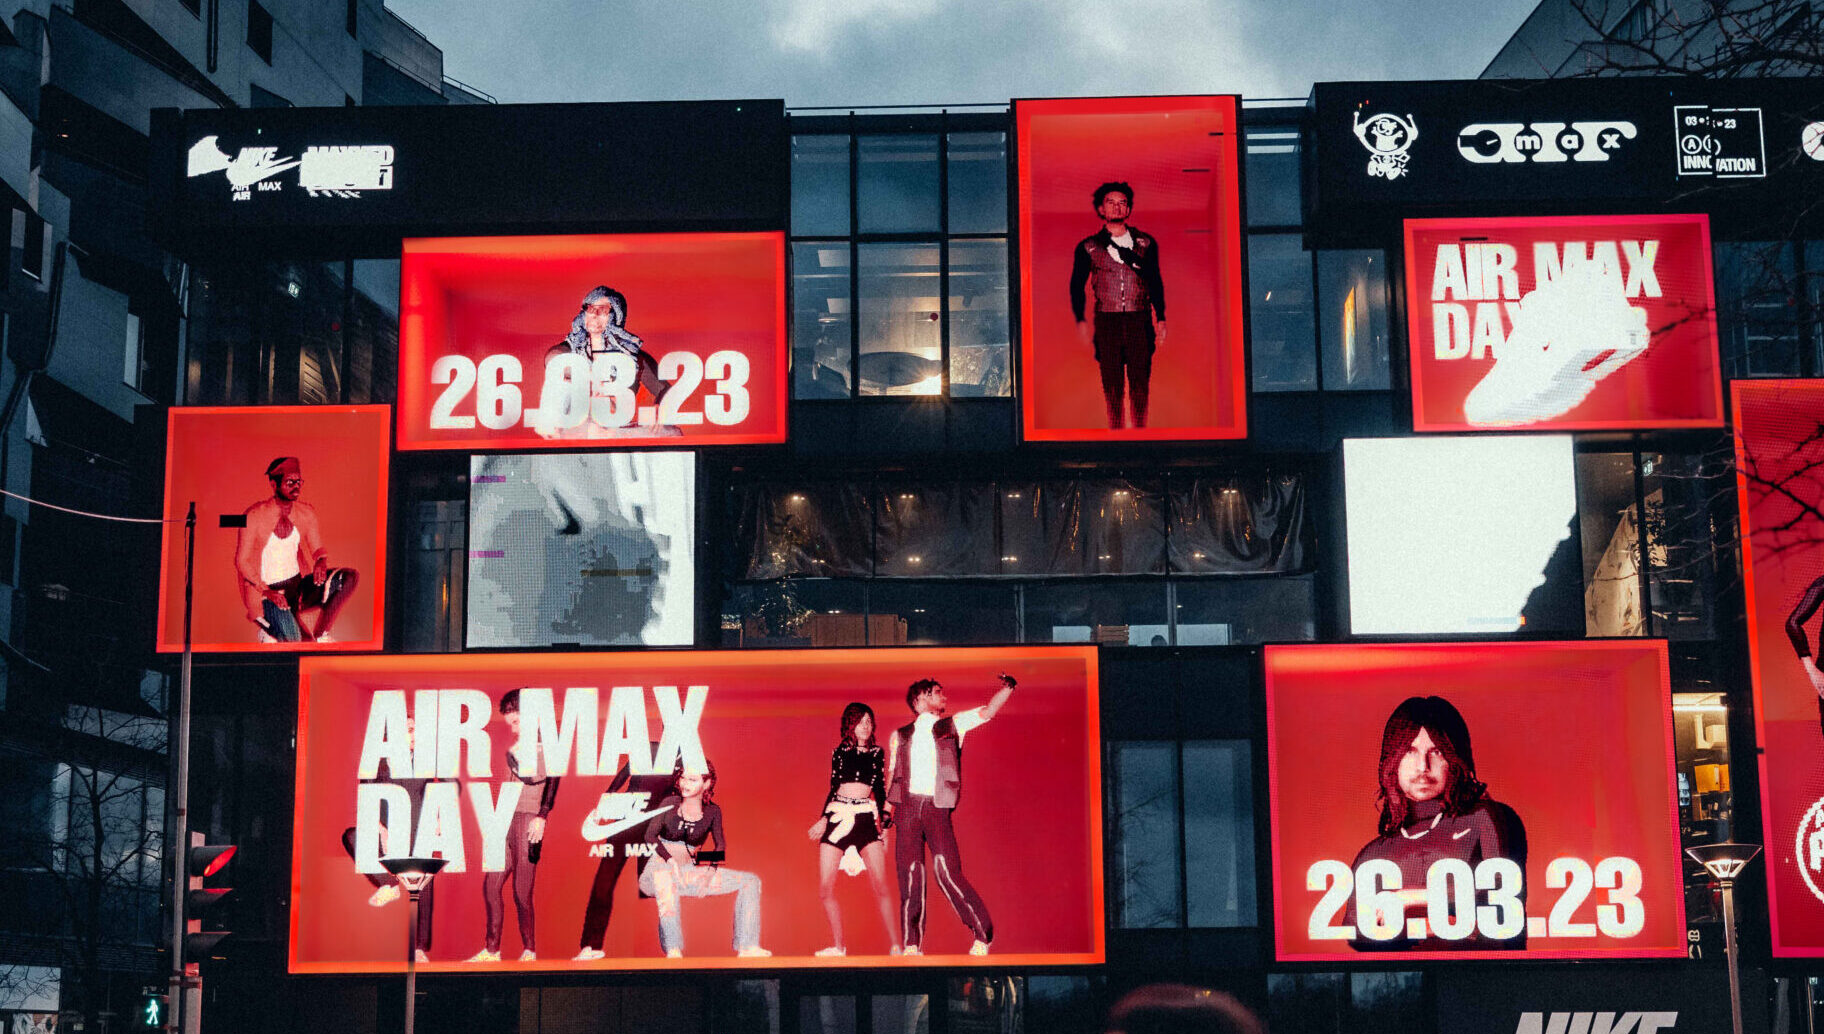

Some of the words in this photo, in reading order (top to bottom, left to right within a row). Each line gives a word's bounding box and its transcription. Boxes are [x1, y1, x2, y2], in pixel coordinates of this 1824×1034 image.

[257, 181, 282, 191] MAX
[1431, 242, 1521, 301] AIR
[429, 350, 751, 430] 26.03.23
[358, 688, 493, 779] AIR
[516, 686, 710, 777] MAX
[354, 781, 524, 875] DAY
[588, 843, 615, 858] AIR
[624, 843, 659, 858] MAX
[1306, 856, 1646, 941] 26.03.23
